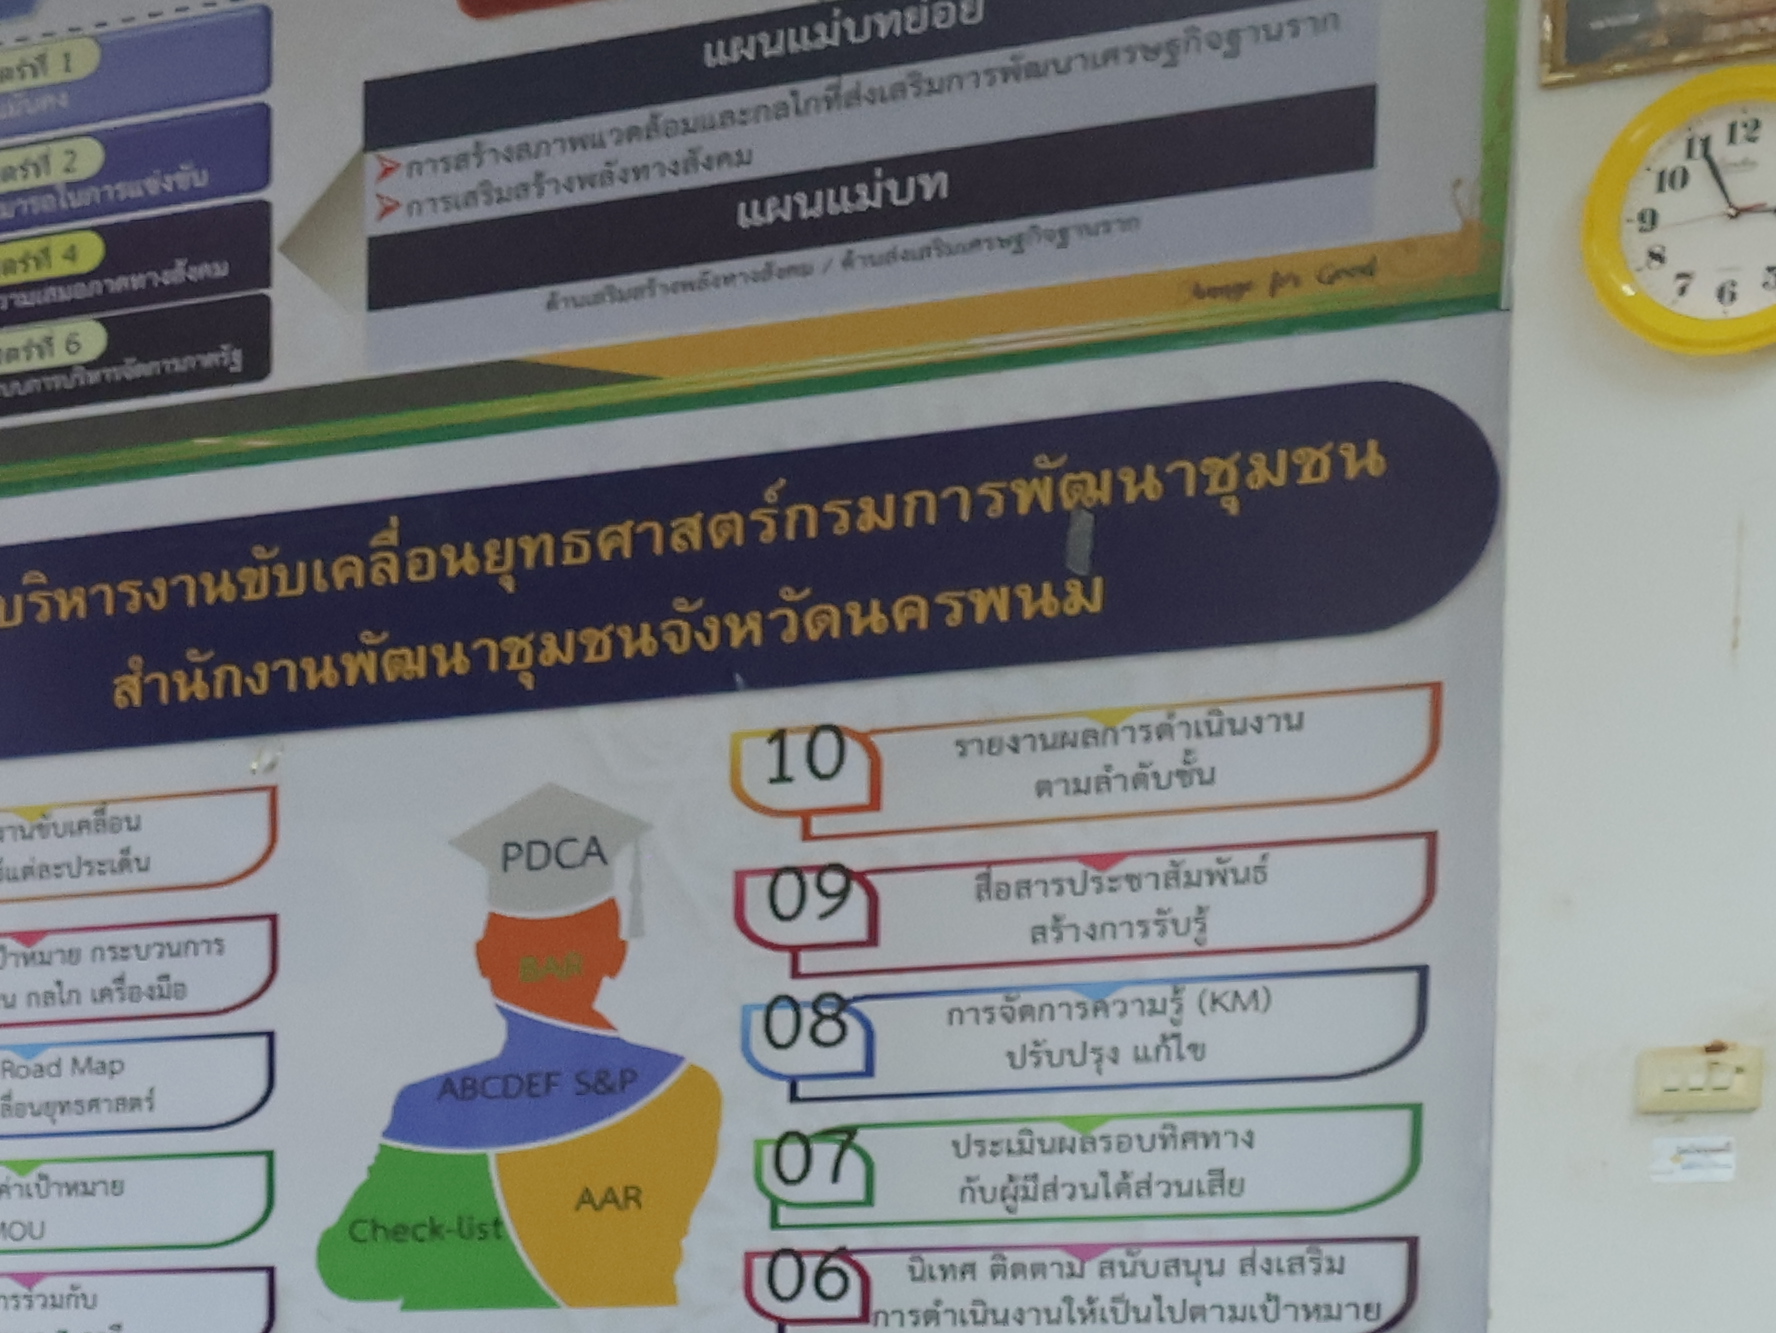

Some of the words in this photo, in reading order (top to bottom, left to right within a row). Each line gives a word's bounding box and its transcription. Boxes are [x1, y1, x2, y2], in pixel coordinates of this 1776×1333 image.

[62, 52, 74, 75] 1
[1726, 117, 1762, 146] 12
[63, 150, 78, 173] 2
[1655, 165, 1691, 194] 10
[735, 163, 950, 233] แผนแม่บท
[1637, 208, 1659, 234] 9
[63, 242, 79, 266] 4
[1646, 245, 1667, 271] 8
[1674, 272, 1696, 297] 7
[1717, 279, 1738, 307] 6
[64, 331, 82, 356] 6
[111, 574, 1106, 711] สำนักงานพัฒนาชุมชนจังหวัดนครพนม
[954, 706, 1305, 759] รายงานผลการดำเนินงาน
[763, 722, 848, 786] 10
[501, 835, 609, 873] PDCA
[766, 861, 855, 924] 09
[973, 852, 1270, 904] สื่อสารประชาสัมพันธ์
[1029, 905, 1211, 949] สร้างการรับรู้
[91, 935, 226, 965] กระบวนการ
[518, 951, 585, 983] BAR
[90, 971, 189, 1007] เครื่องมือ
[946, 989, 1185, 1029] การจัดการความรู้
[1196, 985, 1274, 1019] (KM)
[762, 990, 851, 1052] 08
[0, 1055, 63, 1082] Road
[69, 1054, 125, 1084] Map
[1006, 1037, 1121, 1076] ปรับปรุง
[1133, 1028, 1207, 1063] แก้ไข
[436, 1069, 561, 1103] ABCDEF
[574, 1067, 639, 1096] S&P
[773, 1125, 860, 1187] 07
[574, 1185, 643, 1212] AAR
[959, 1171, 1246, 1217] กับผู้มีส่วนได้ส่วนเสีย
[347, 1215, 504, 1246] Check-list
[766, 1245, 850, 1304] 06
[990, 1250, 1086, 1282] ติดตาม
[1098, 1248, 1227, 1288] สนับสนุน
[1238, 1246, 1347, 1280] ส่งเสริม
